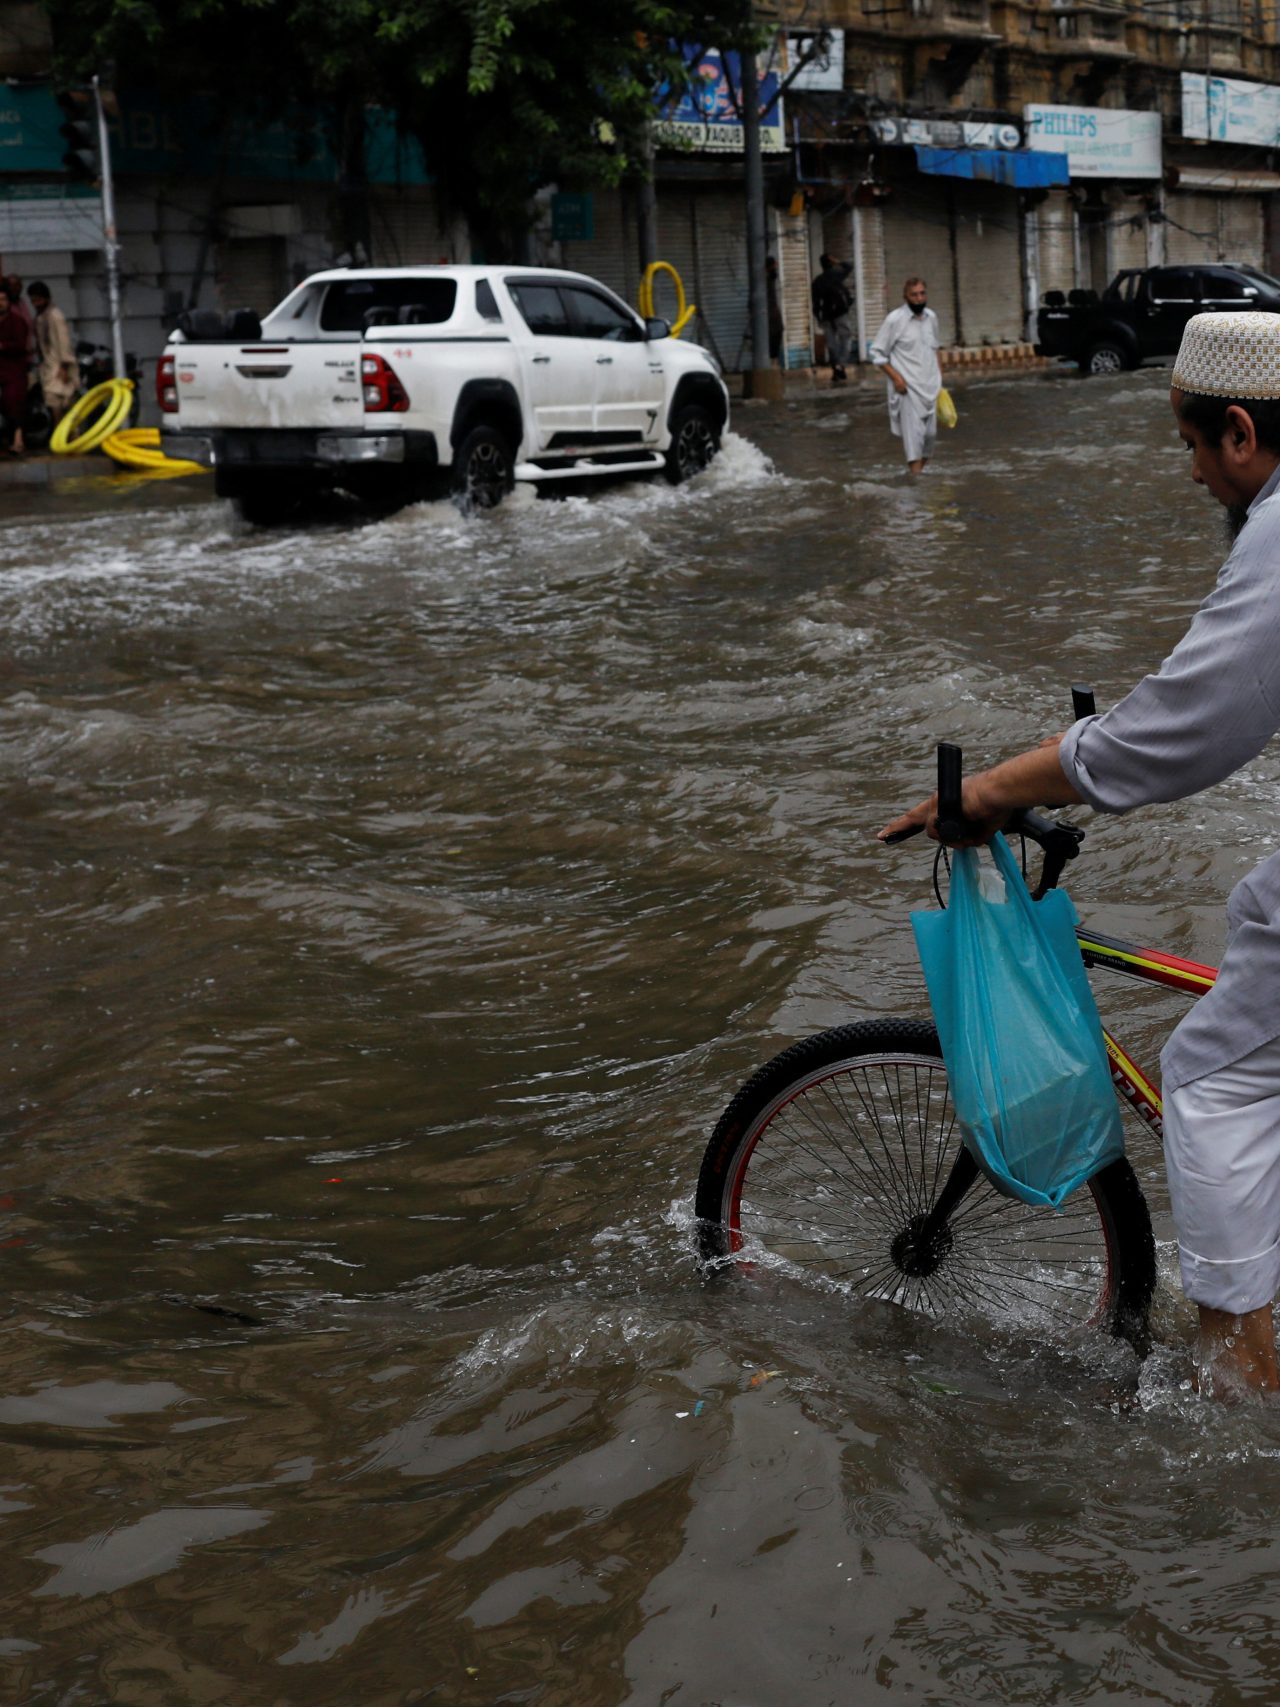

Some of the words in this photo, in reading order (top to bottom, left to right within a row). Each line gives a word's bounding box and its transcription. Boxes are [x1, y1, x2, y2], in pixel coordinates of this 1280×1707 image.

[1033, 111, 1097, 137] PHILIPS
[1086, 951, 1107, 961] LUXURY
[1108, 956, 1126, 967] BRAND
